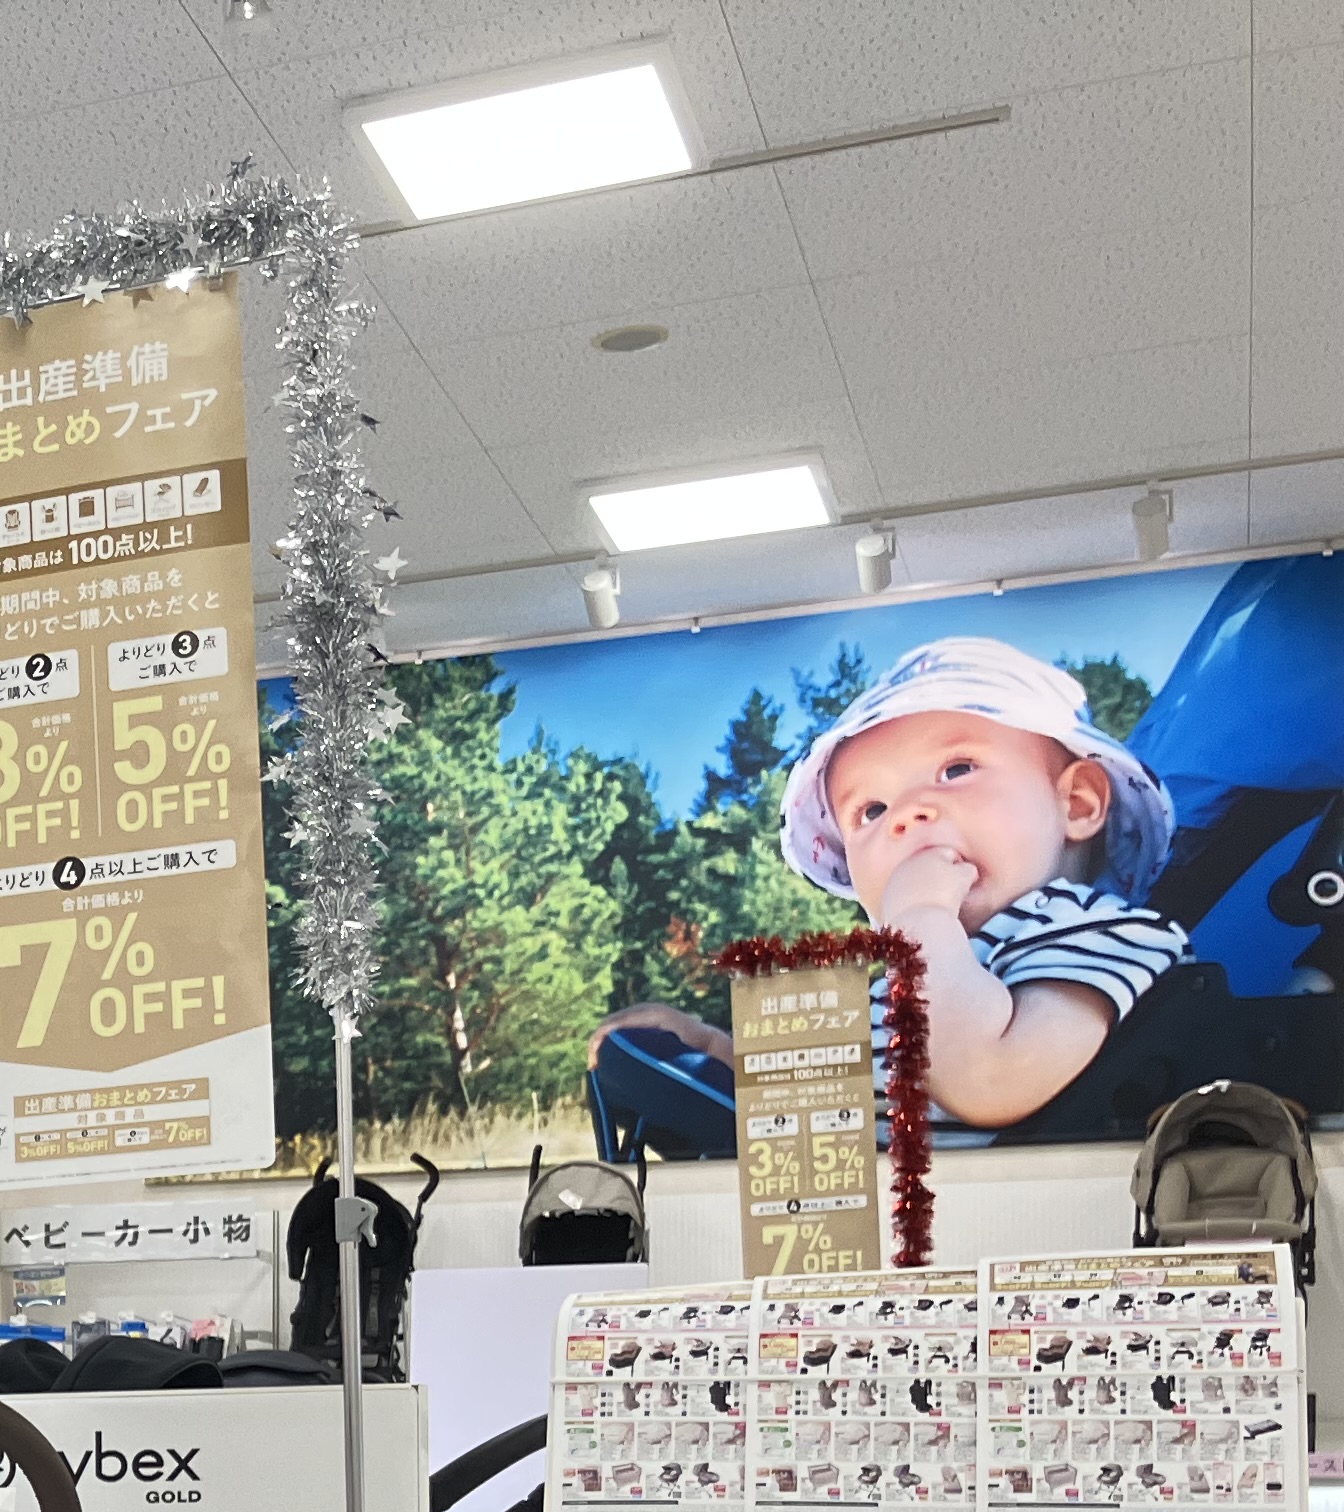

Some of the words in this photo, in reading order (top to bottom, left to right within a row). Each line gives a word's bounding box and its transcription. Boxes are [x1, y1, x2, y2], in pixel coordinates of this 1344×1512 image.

[0, 568, 183, 616] 期間中、対象商品を
[138, 660, 197, 681] ご購入で
[116, 778, 229, 832] OFF!
[62, 889, 144, 912] 合計価格より
[90, 975, 226, 1037] OFF!
[24, 1084, 196, 1115] 出産準備おまとめフェア
[750, 1175, 799, 1197] OFF!
[814, 1171, 864, 1192] OFF!
[3, 1214, 252, 1249] ベビーカー小物
[803, 1250, 863, 1274] OFF!
[56, 1431, 201, 1486] ybex
[146, 1490, 202, 1503] GOLD
